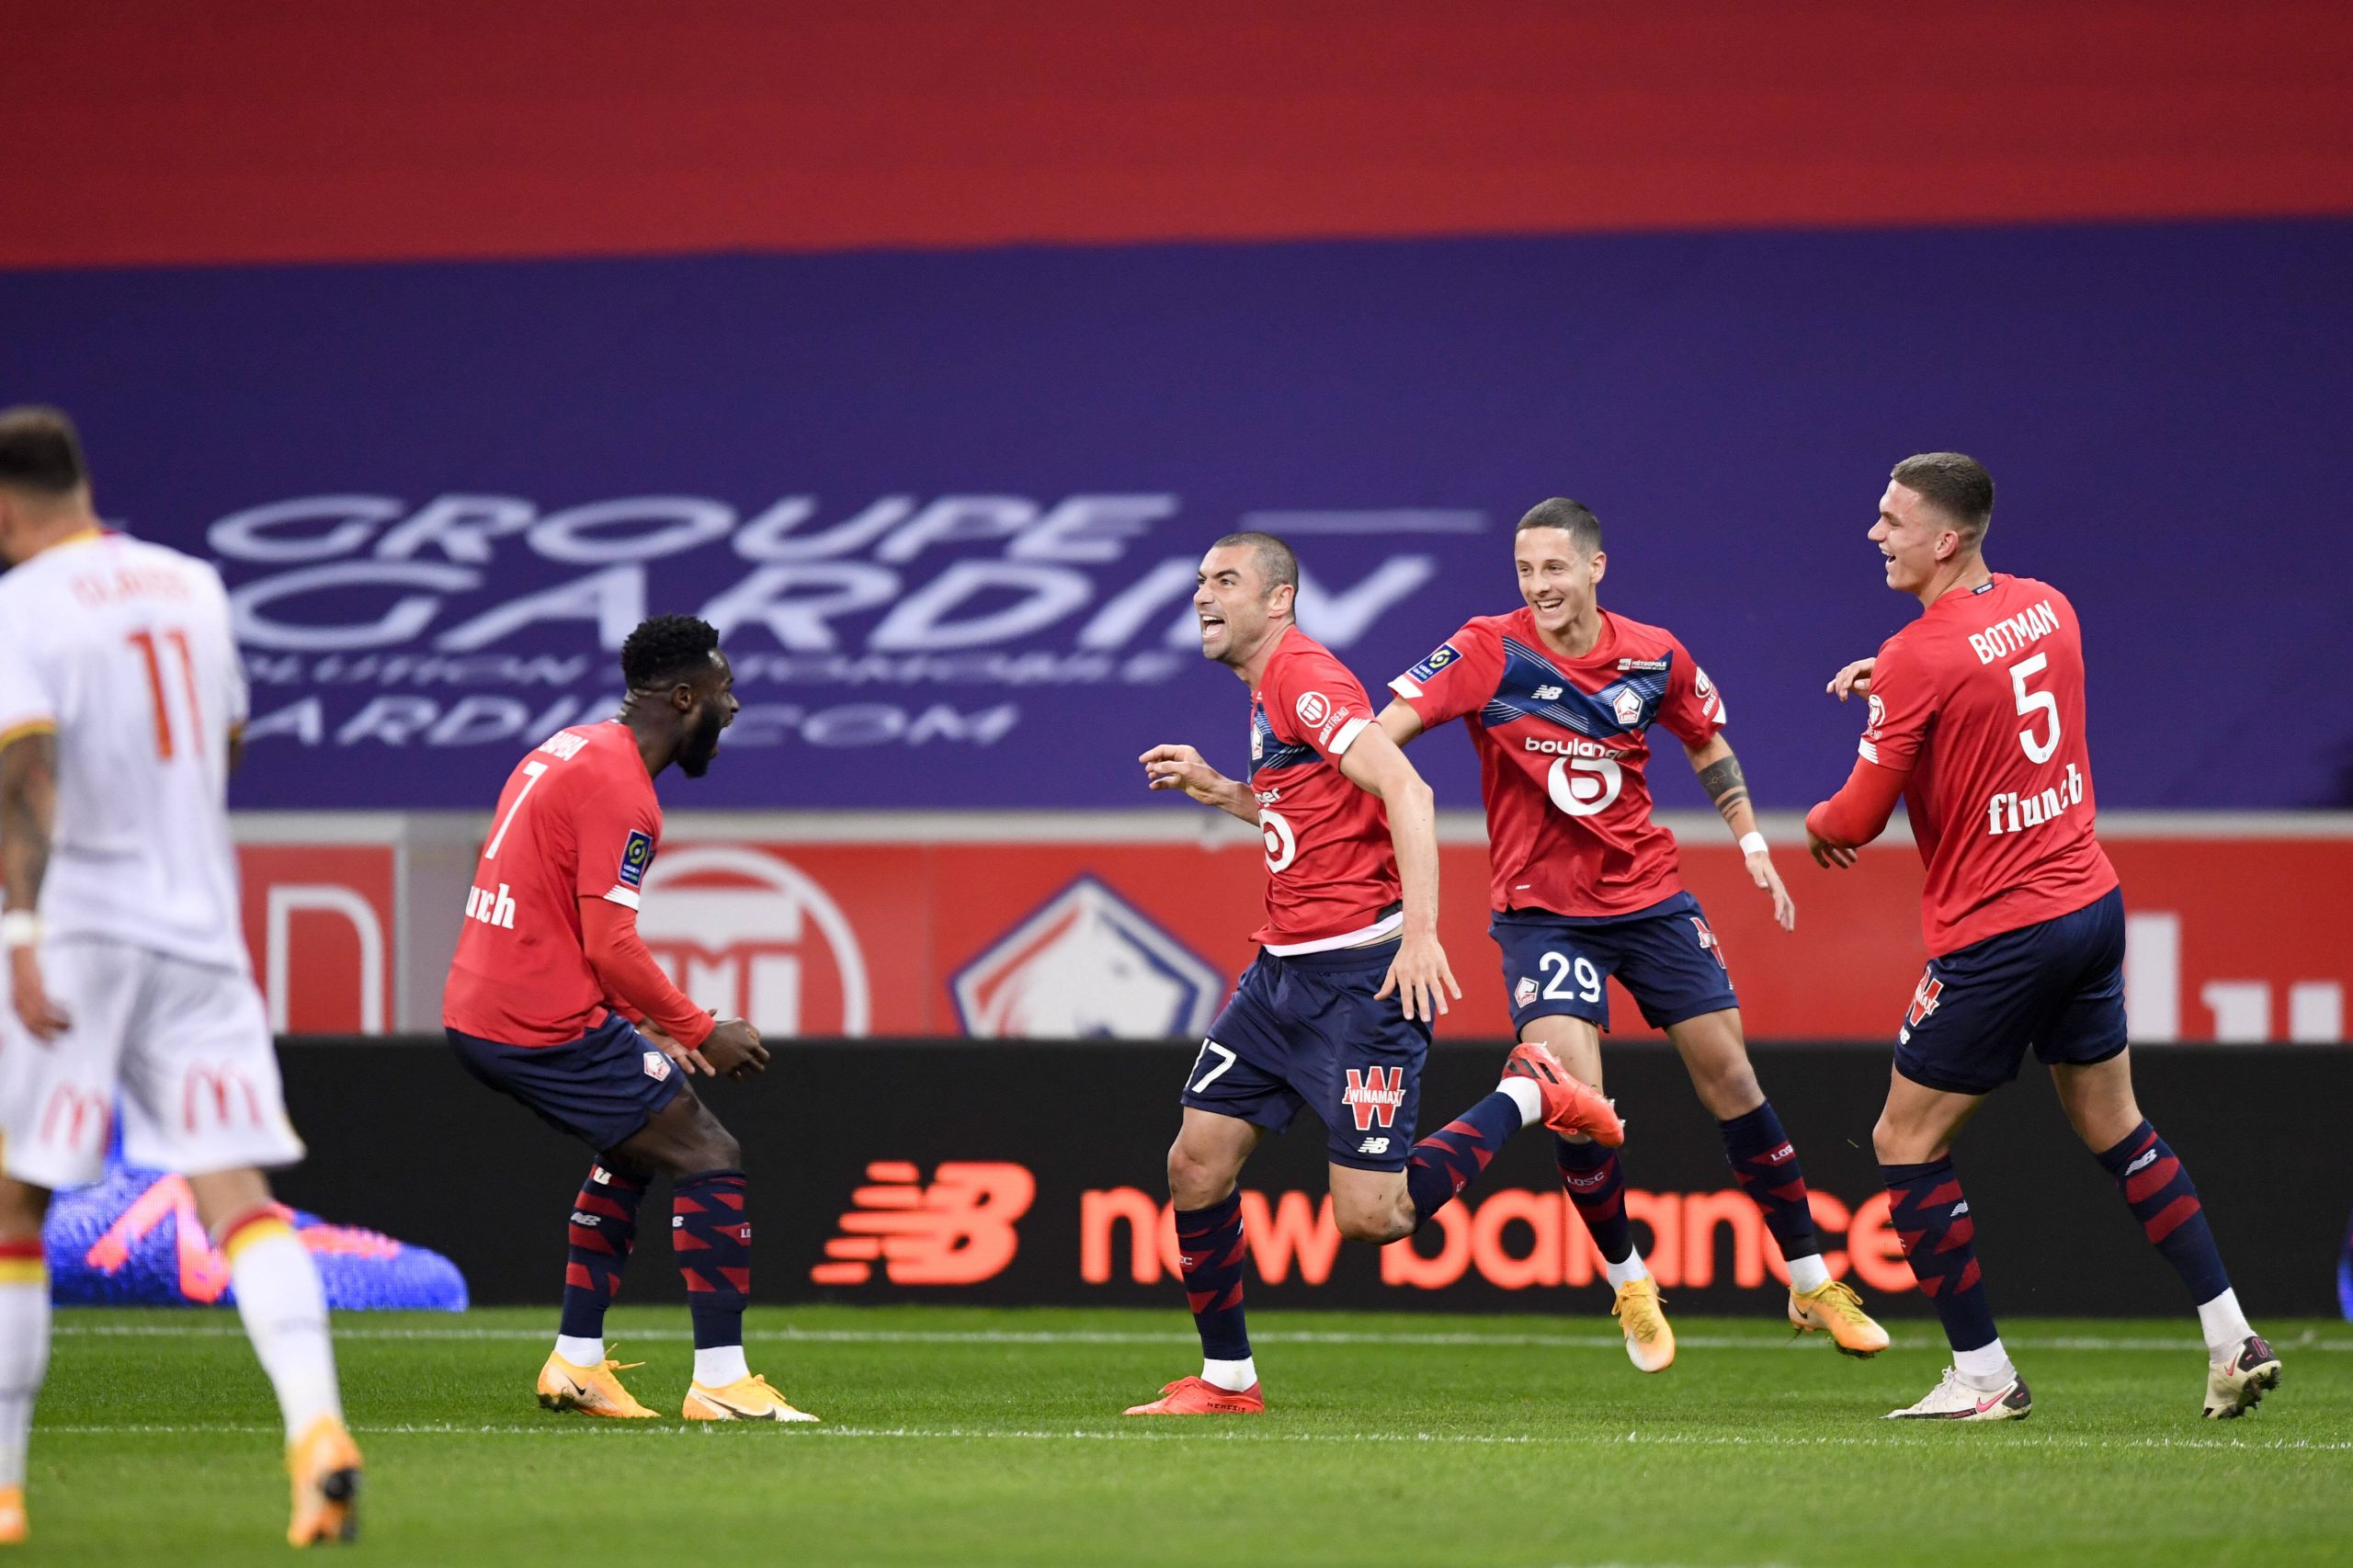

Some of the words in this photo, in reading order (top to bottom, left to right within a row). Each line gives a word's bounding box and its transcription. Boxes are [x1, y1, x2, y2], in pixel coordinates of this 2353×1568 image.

[208, 494, 1179, 564] GROUPE
[1968, 599, 2061, 665] BOTMAN
[125, 626, 207, 762] 11
[2008, 651, 2062, 765] 5
[484, 760, 549, 860] 7
[1987, 763, 2084, 835] flunch
[1539, 951, 1601, 1004] 29
[1348, 1088, 1400, 1106] WINAMAX
[1566, 1171, 1605, 1187] LOSC
[1207, 1402, 1246, 1414] NEMESIS
